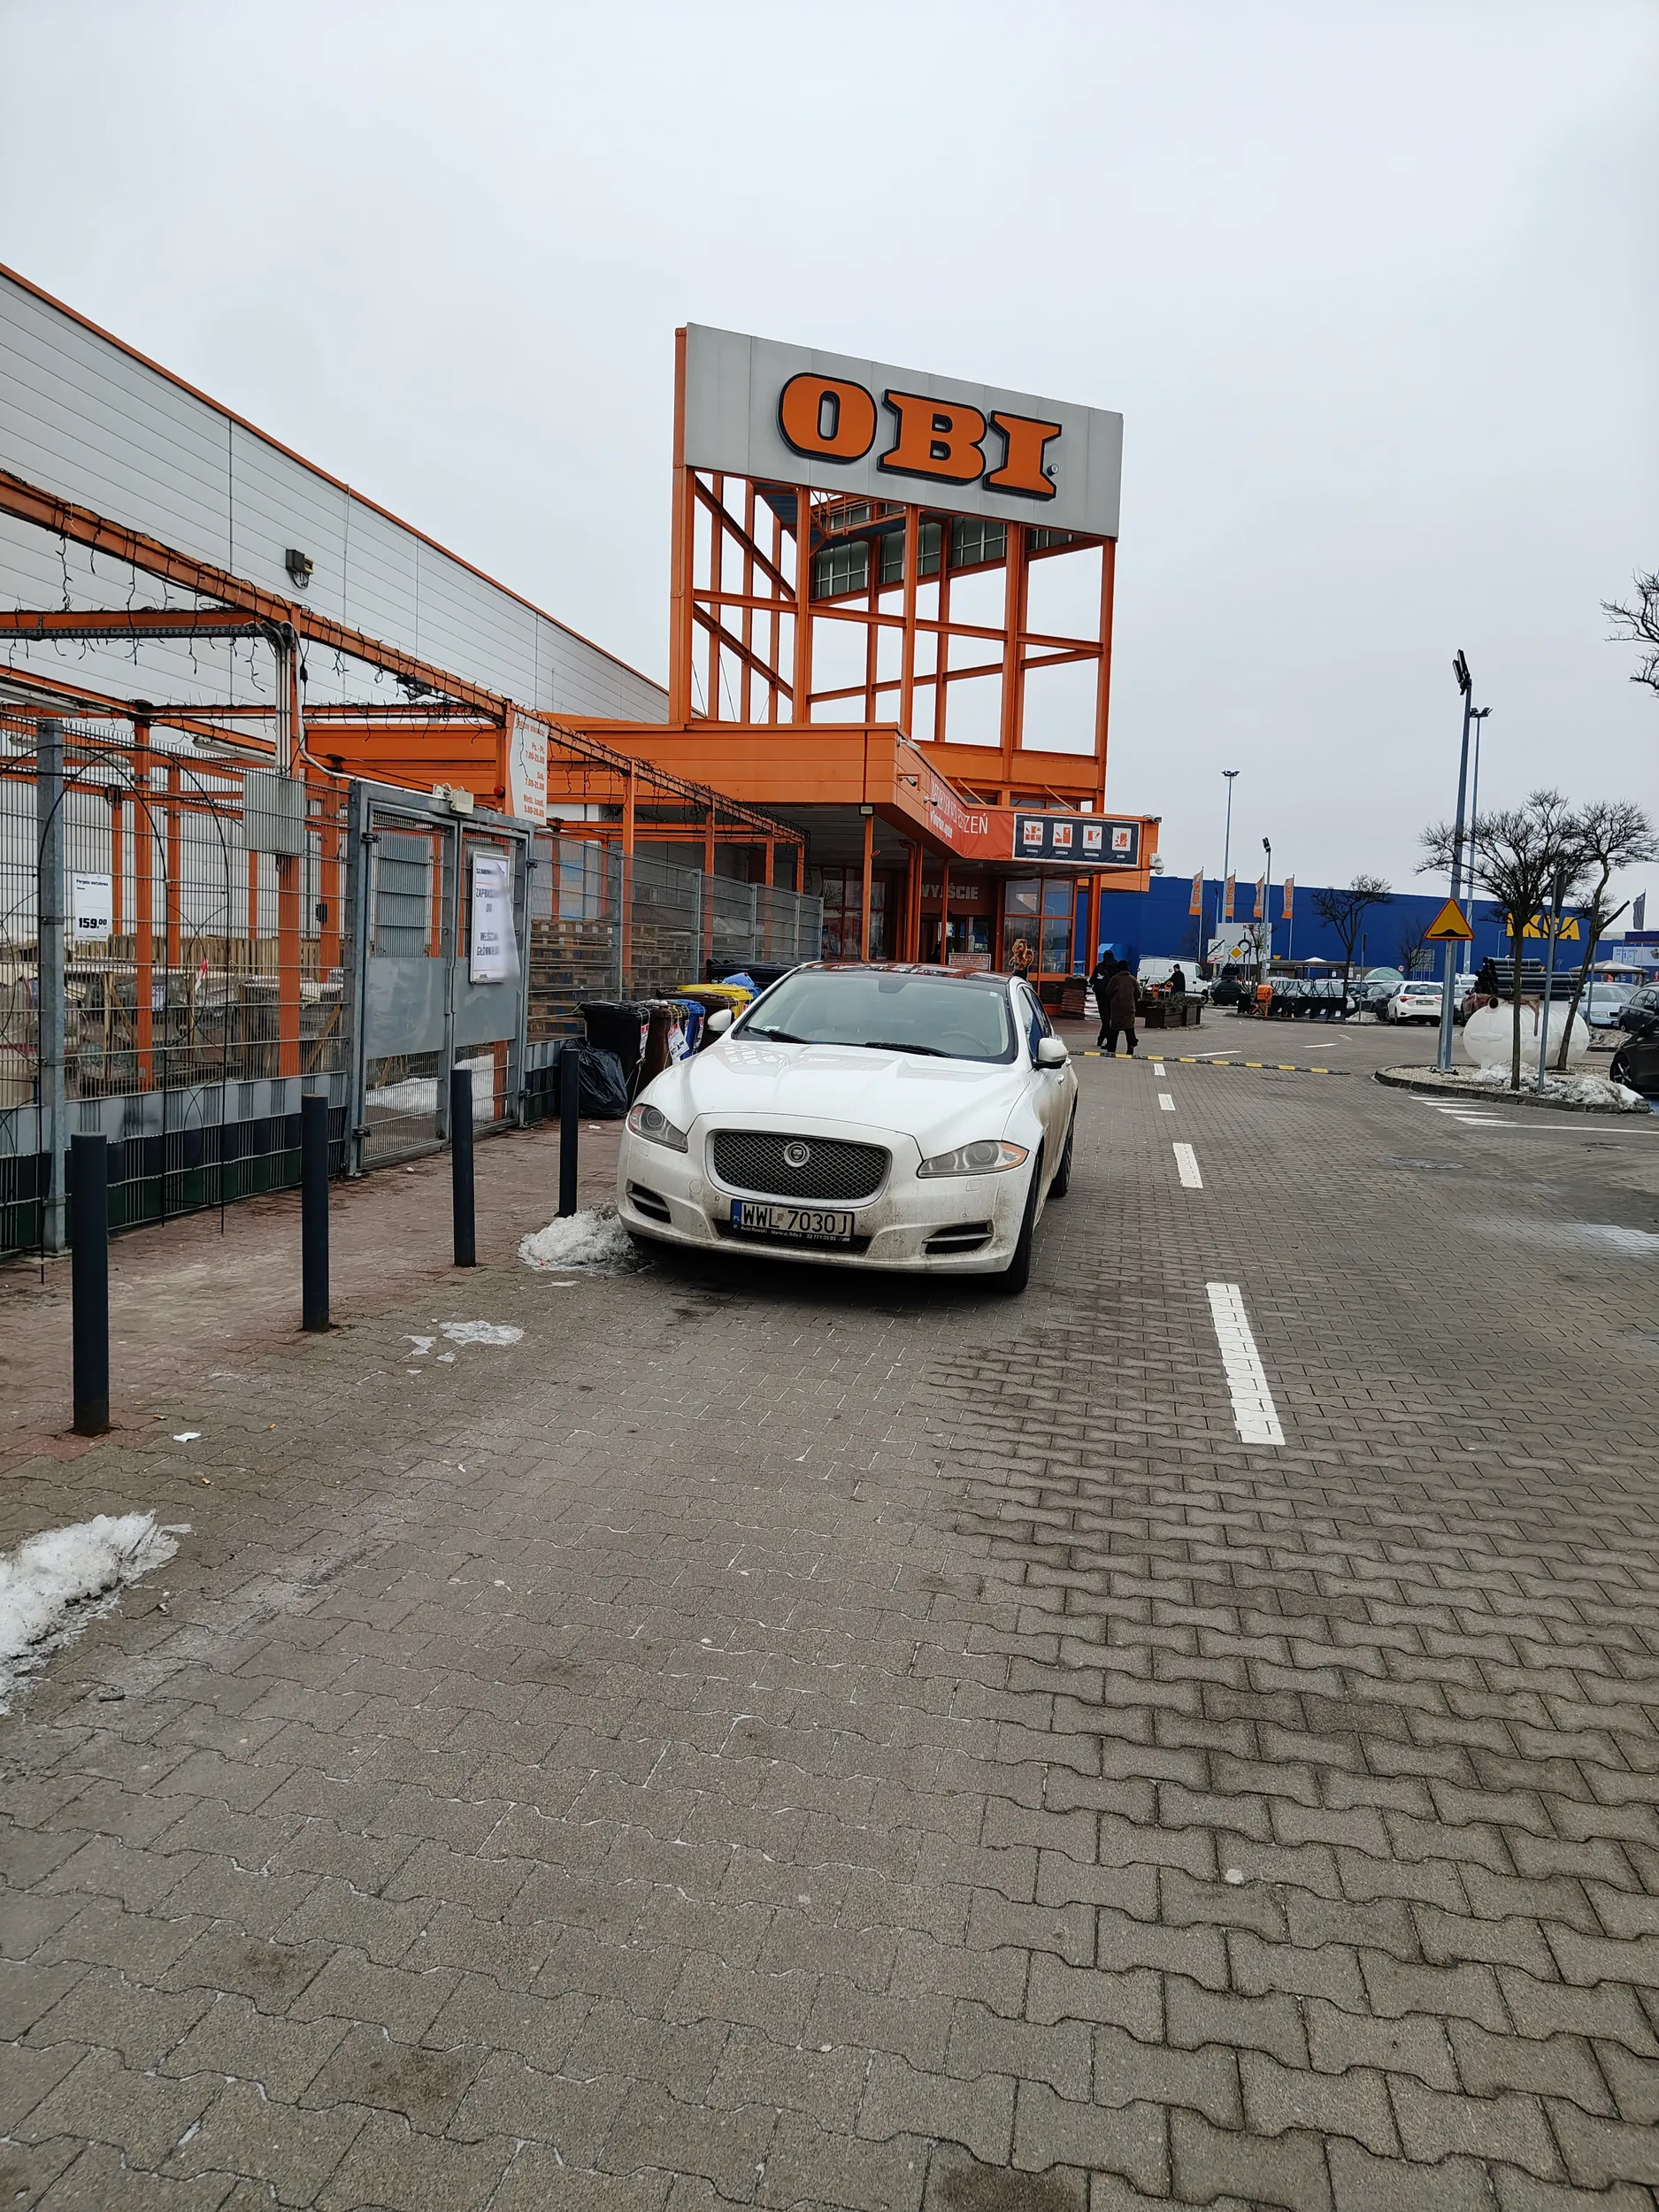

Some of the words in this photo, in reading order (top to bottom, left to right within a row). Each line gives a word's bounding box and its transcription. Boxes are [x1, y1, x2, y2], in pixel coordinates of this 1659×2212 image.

[777, 373, 1062, 501] OBI
[1506, 912, 1580, 941] IKEA
[743, 1204, 780, 1228] WWL
[787, 1210, 848, 1235] 7030J
